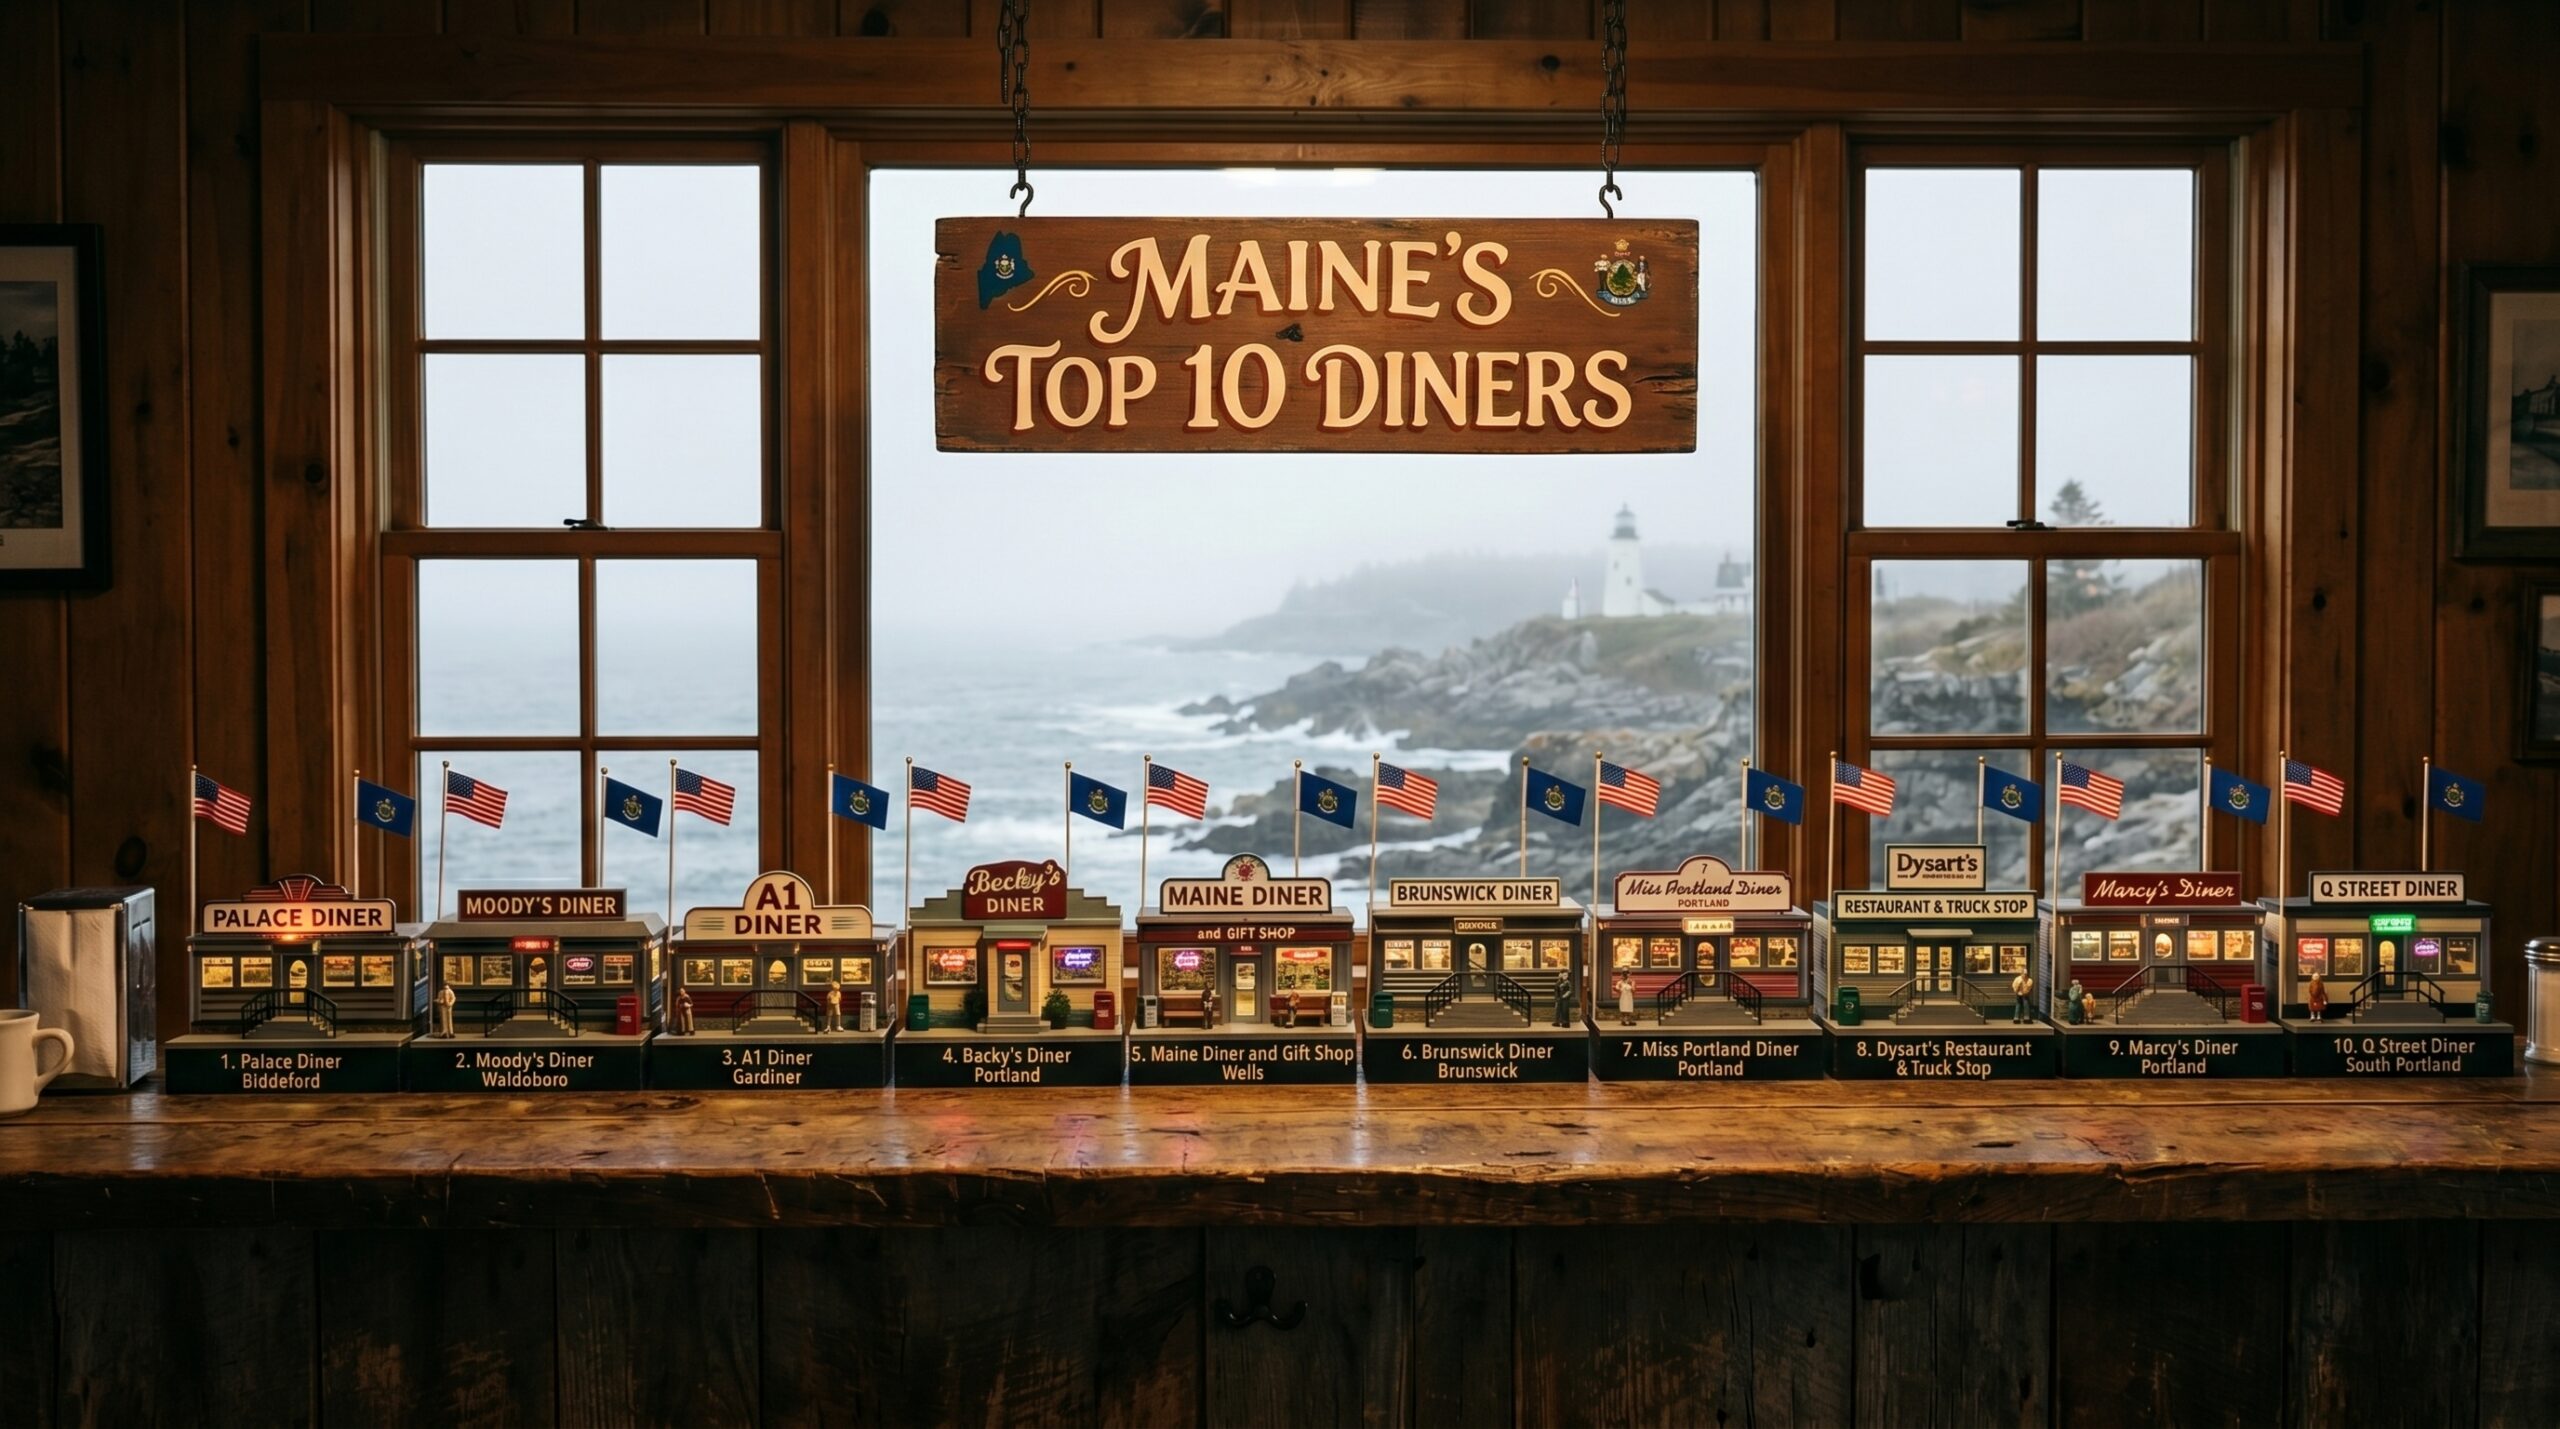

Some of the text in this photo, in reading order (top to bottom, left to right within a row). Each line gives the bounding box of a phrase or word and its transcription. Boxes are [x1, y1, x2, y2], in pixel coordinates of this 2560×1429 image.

[1089, 231, 1513, 344] MAINE'S
[984, 340, 1633, 431] TOP 10 DINERS
[1701, 863, 1708, 874] 7
[1896, 853, 1978, 878] Dysart's
[755, 880, 801, 911] A1
[1168, 886, 1323, 906] MAINE DINER
[1397, 885, 1553, 901] BRUNSWICK DINER
[1735, 880, 1783, 896] Diner
[2092, 878, 2236, 904] Marcy's Diner
[2319, 880, 2458, 898] Q STREET DINER
[466, 896, 617, 915] MOODY'S DINER
[986, 897, 1044, 913] DINER
[1677, 898, 1730, 908] PORTLAND
[1844, 899, 2029, 914] RESTAURANT & TRUCK STOP
[213, 908, 383, 928] PALACE DINER
[734, 914, 822, 935] DINER
[1197, 927, 1296, 940] and GIFT SHOP
[1131, 1044, 1354, 1065] 5. Maine Diner and Gift Shop
[1402, 1043, 1554, 1060] 6. Brunswick Diner
[1622, 1040, 1799, 1057] 7. Miss Portland Diner
[1856, 1040, 2032, 1061] 8. Dysart's Restaurant
[2108, 1039, 2239, 1060] 9. Marcy's Diner
[2333, 1037, 2476, 1057] 10. Q Street Diner
[220, 1053, 342, 1069] 1. Palace Diner
[455, 1051, 594, 1072] 2. Moody's Diner
[722, 1049, 813, 1065] 3. A1 Diner
[942, 1047, 1072, 1067] 4. Backy's Diner
[2346, 1055, 2462, 1073] South Portland
[974, 1066, 1041, 1083] Portland
[1222, 1064, 1264, 1081] Wells
[1438, 1062, 1518, 1079] Brunswick
[1678, 1060, 1744, 1077] Portland
[1896, 1059, 1992, 1079] & Truck Stop
[2141, 1058, 2207, 1075] Portland
[242, 1073, 321, 1089] Biddeford
[482, 1071, 569, 1088] Waldoboro
[732, 1068, 802, 1085] Gardiner
